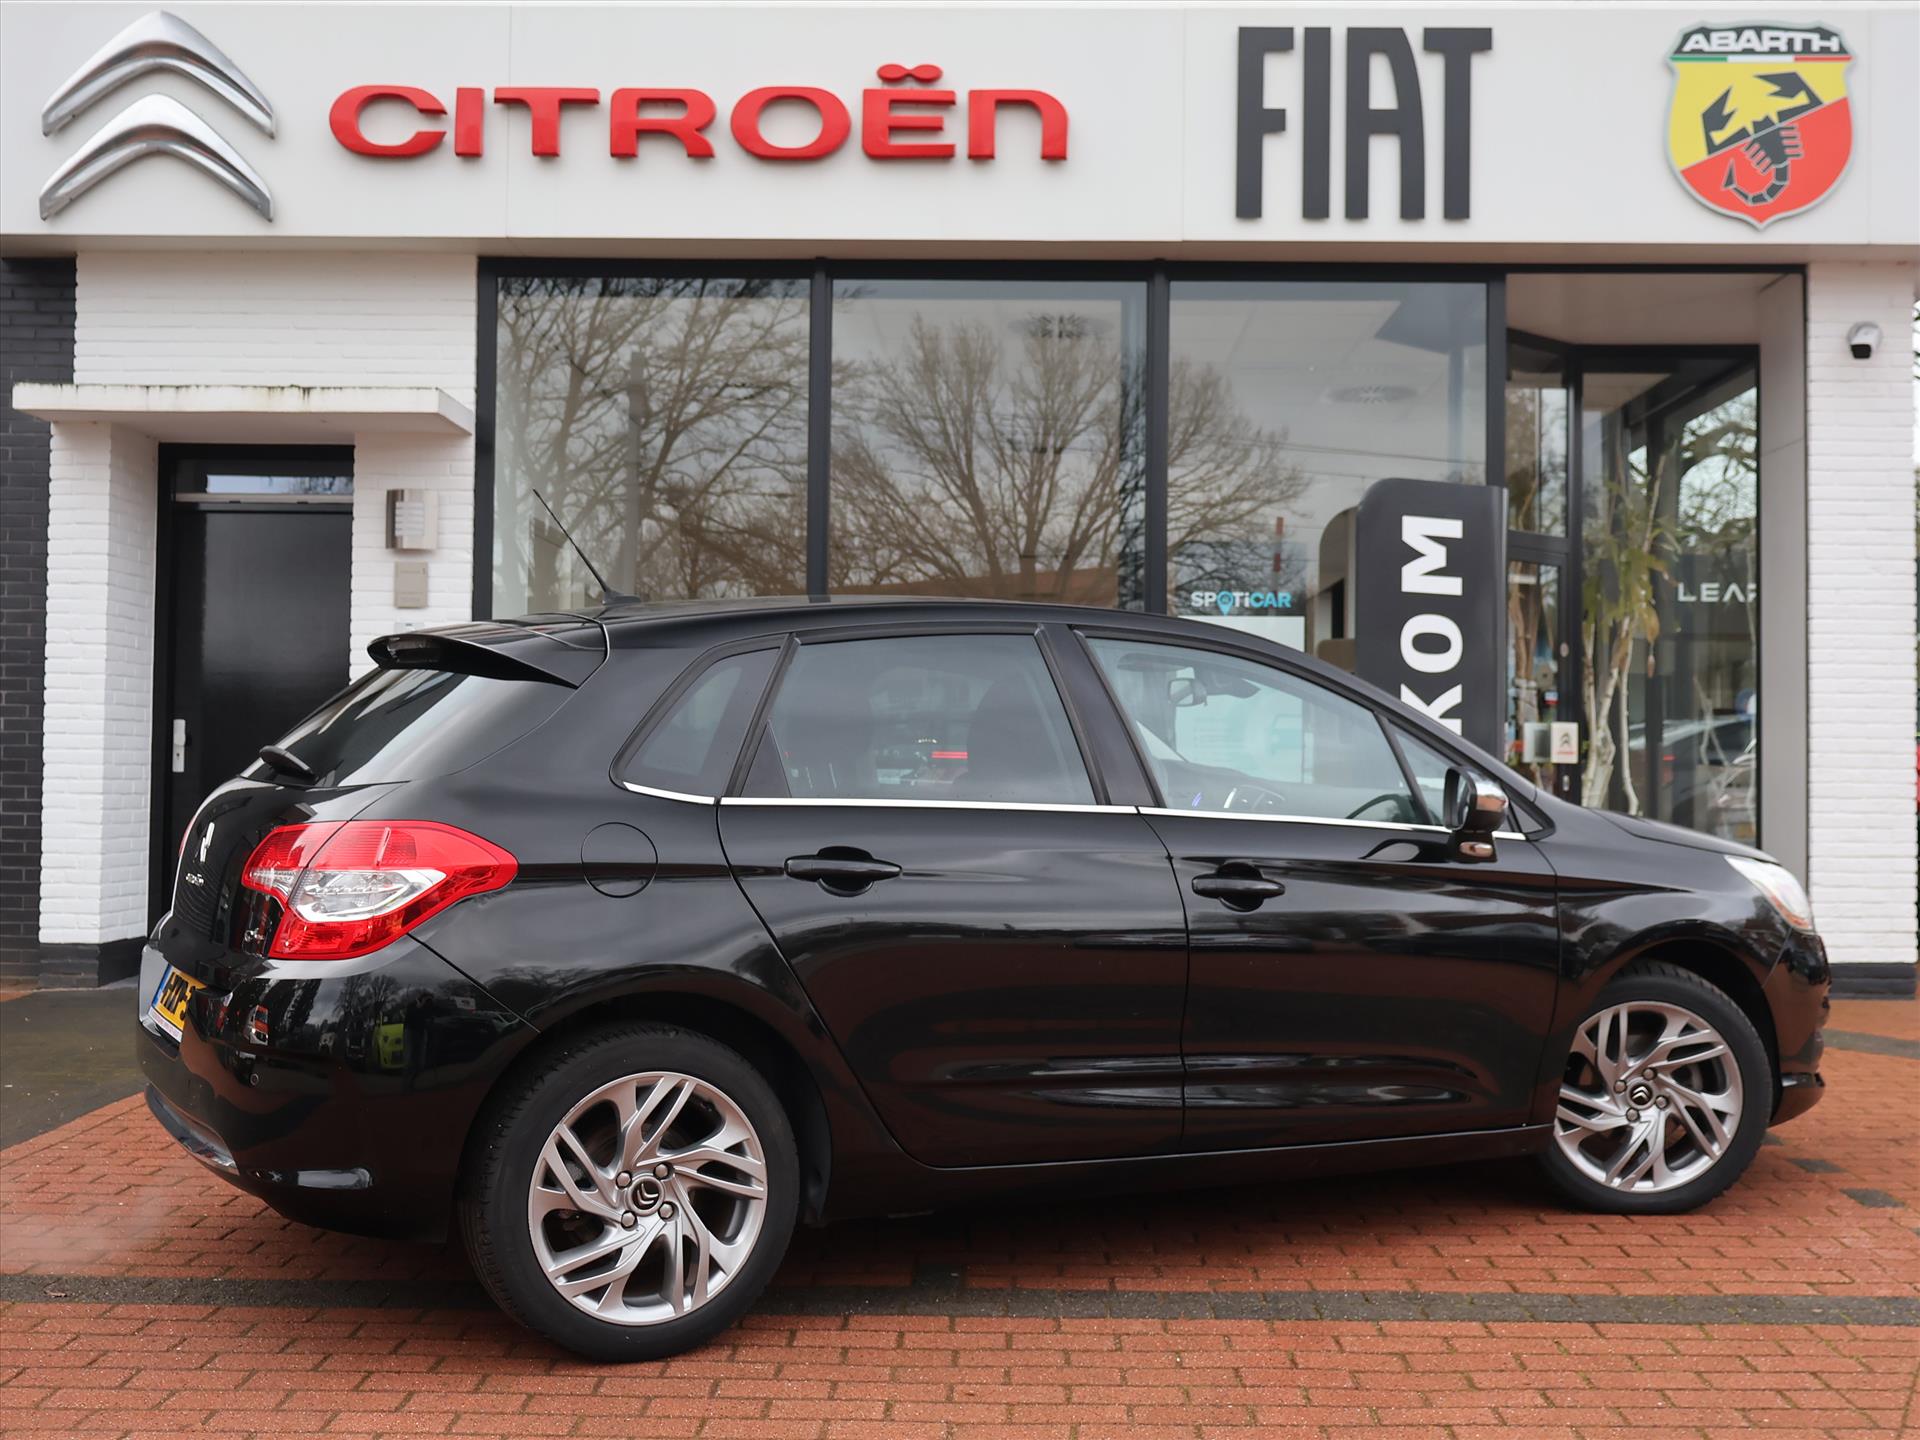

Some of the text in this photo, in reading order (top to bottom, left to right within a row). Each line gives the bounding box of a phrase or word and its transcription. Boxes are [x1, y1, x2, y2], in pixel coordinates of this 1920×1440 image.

[1682, 29, 1840, 52] ABARTH
[329, 63, 1068, 160] CITROËN
[1236, 26, 1492, 220] FIAT
